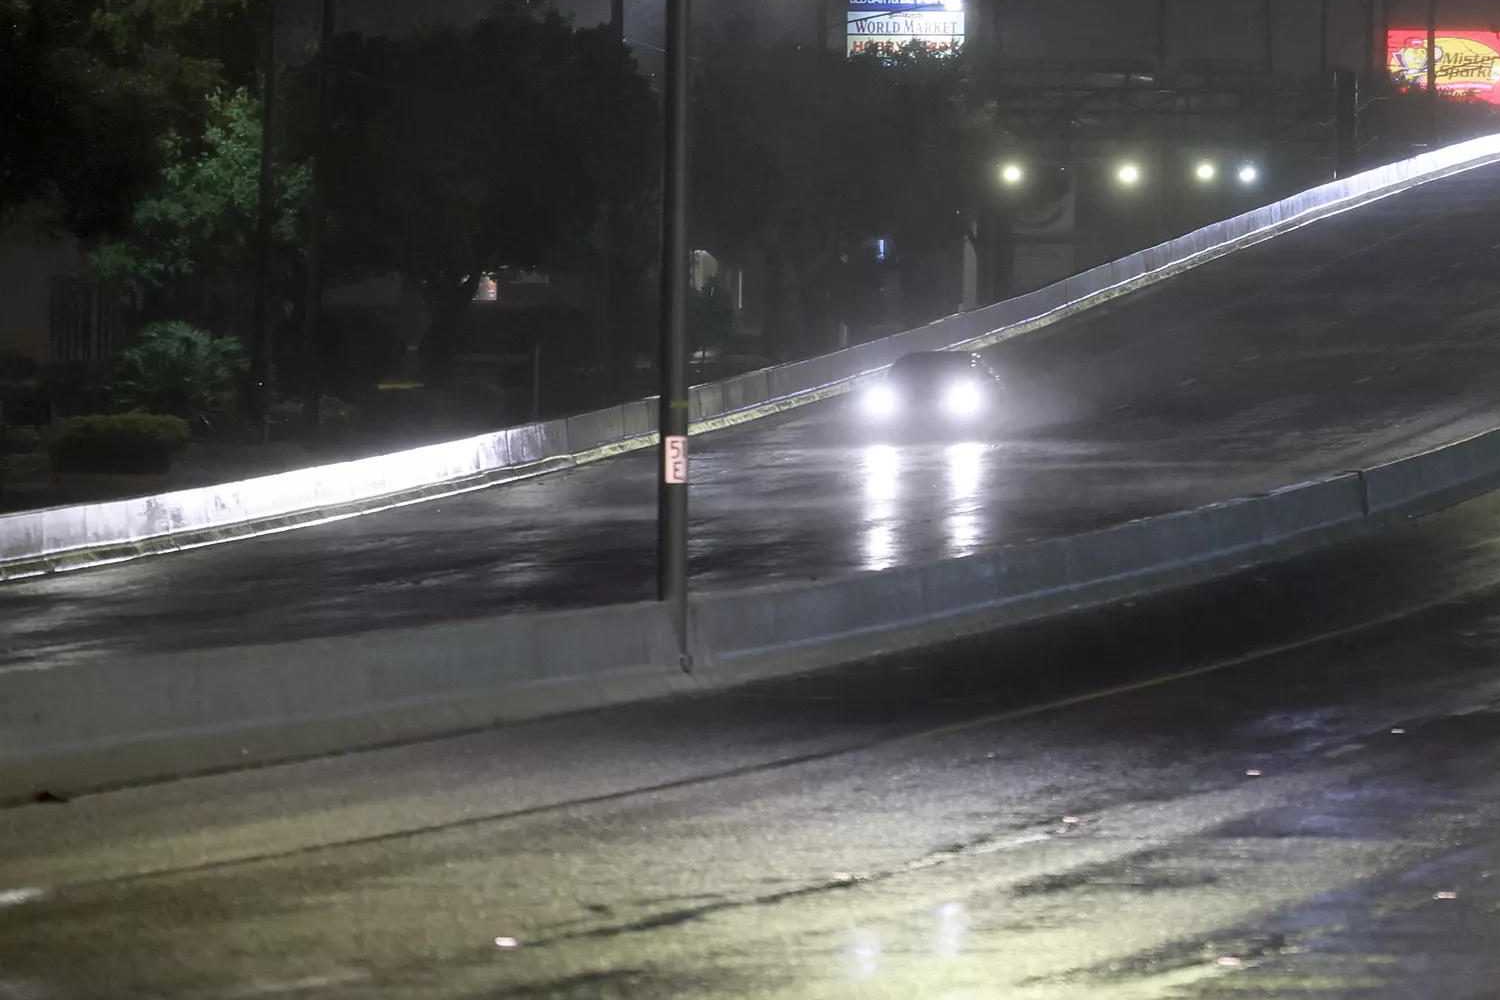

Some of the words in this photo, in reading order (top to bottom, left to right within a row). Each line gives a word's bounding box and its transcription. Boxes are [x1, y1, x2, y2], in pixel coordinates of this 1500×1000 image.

[855, 19, 900, 34] WORLD
[903, 19, 958, 34] MARKET
[1442, 52, 1496, 65] Mister
